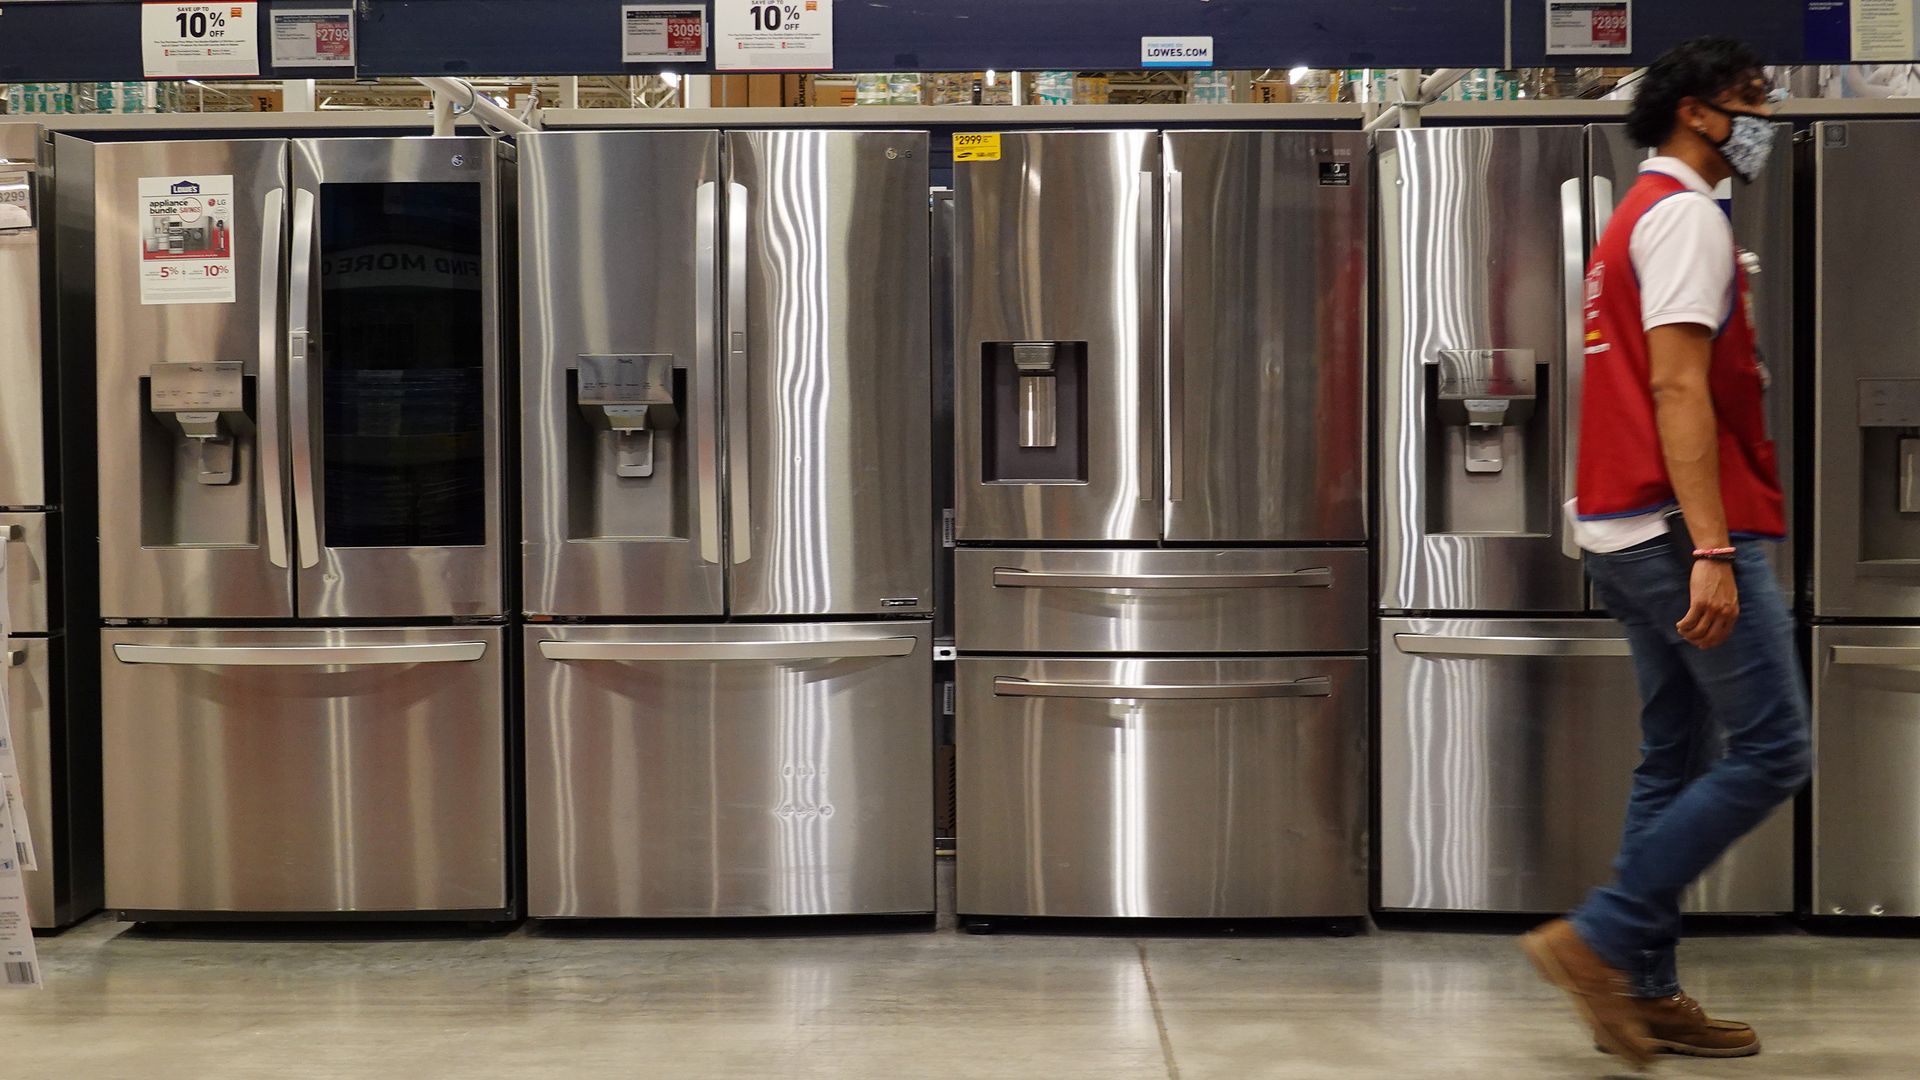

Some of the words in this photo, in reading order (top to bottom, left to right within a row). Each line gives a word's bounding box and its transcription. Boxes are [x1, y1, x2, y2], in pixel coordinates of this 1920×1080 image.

[750, 5, 800, 31] 10%
[1592, 16, 1627, 29] $2899
[176, 12, 225, 38] 10%
[668, 24, 701, 37] $3099
[316, 29, 349, 41] $2799
[1147, 48, 1208, 57] LOWES.COM
[955, 135, 982, 145] $2999
[149, 199, 189, 208] appliance
[149, 206, 178, 214] bundle
[179, 206, 201, 214] SAVINGS
[160, 266, 179, 278] 5%
[203, 265, 229, 277] 10%
